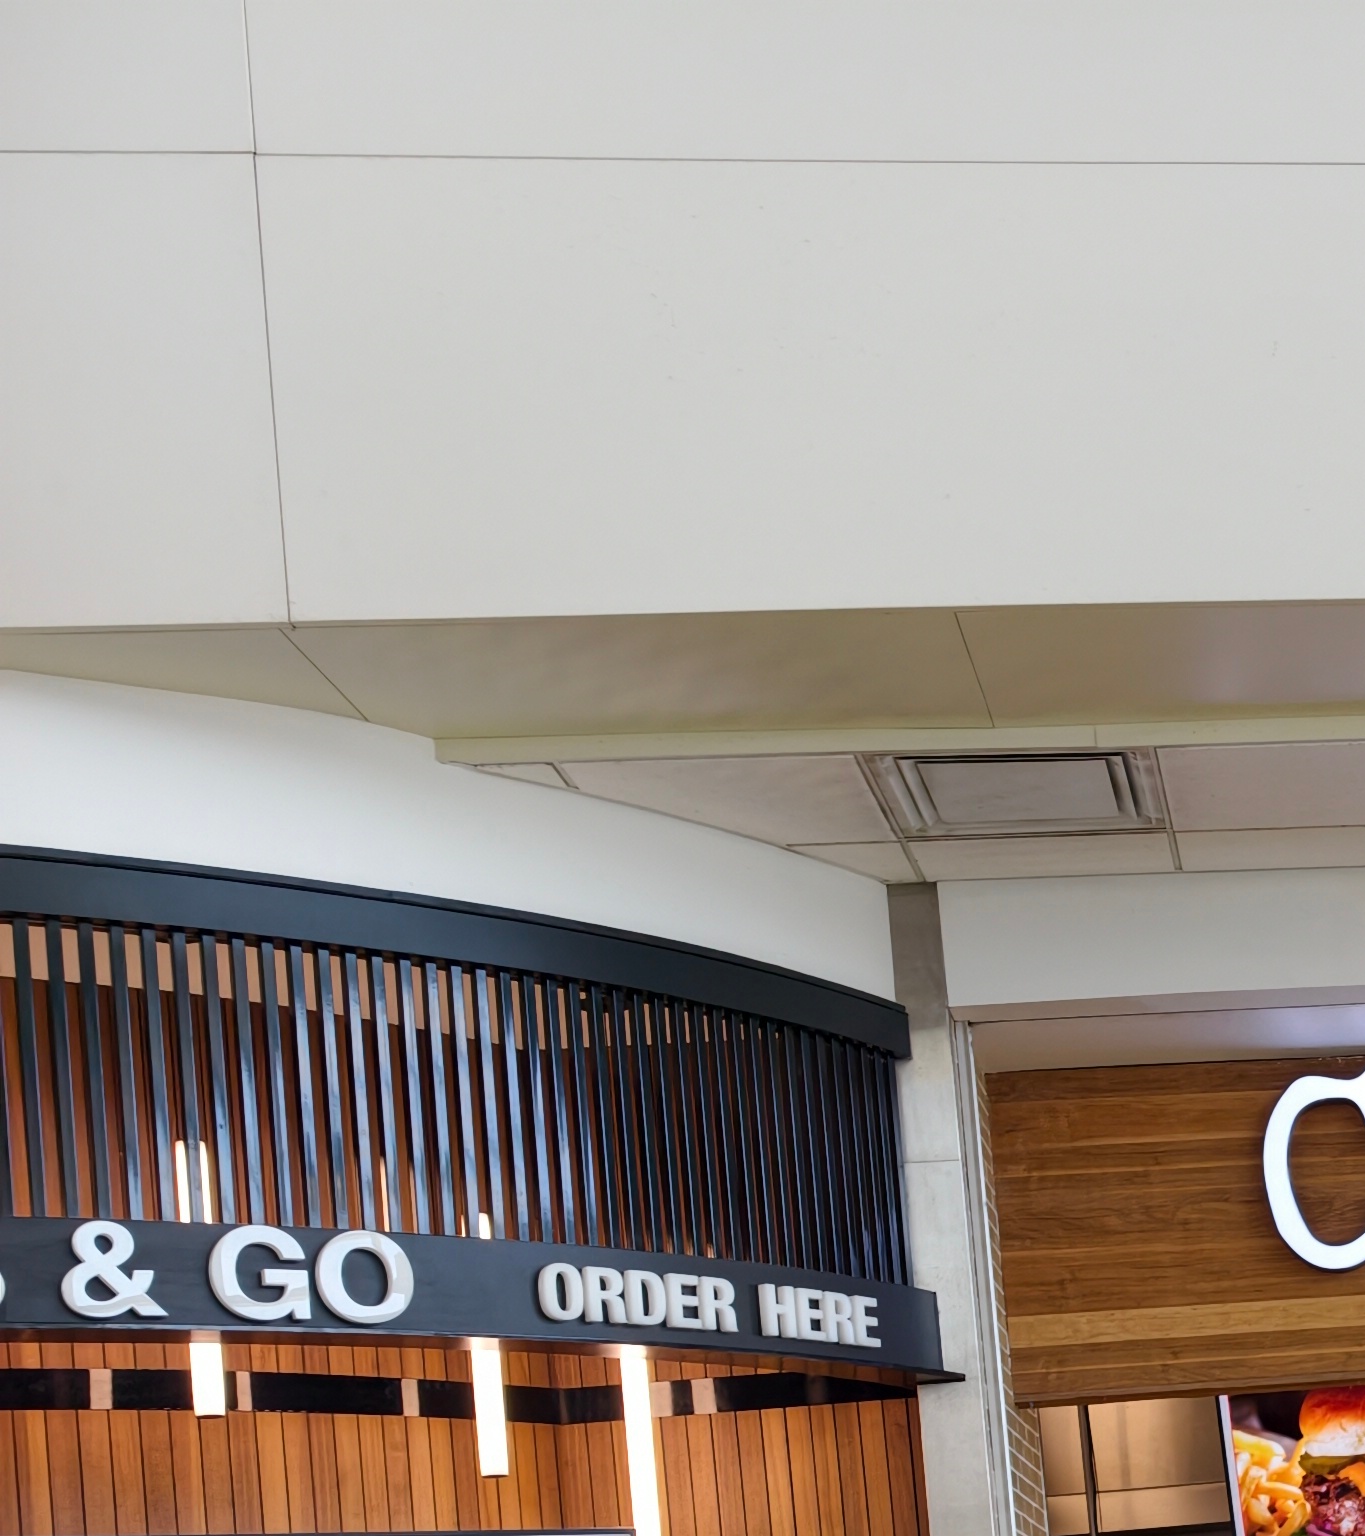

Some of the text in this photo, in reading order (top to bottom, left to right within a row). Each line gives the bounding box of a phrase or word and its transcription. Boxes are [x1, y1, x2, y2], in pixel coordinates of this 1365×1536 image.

[61, 1221, 168, 1321] &
[208, 1226, 414, 1325] GO
[537, 1262, 883, 1348] ORDER HERE
